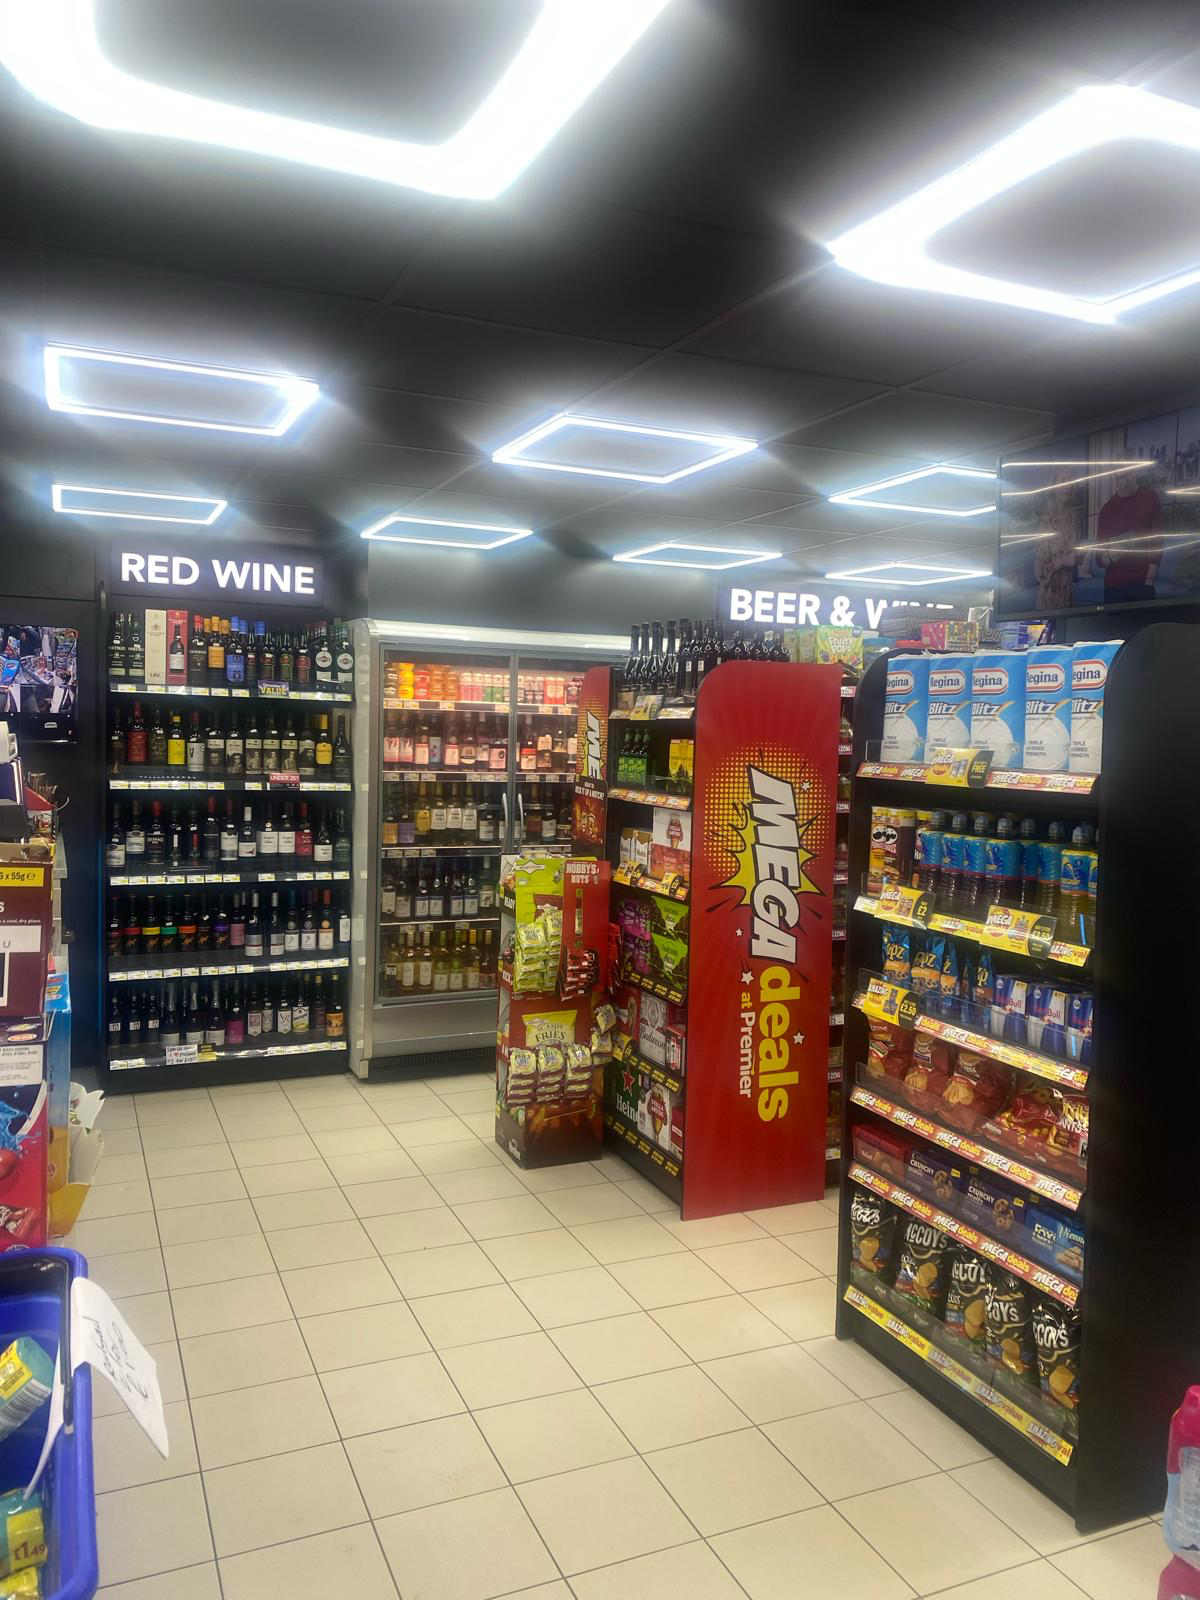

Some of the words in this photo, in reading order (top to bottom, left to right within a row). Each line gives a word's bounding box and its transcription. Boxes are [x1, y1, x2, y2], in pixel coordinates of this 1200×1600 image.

[121, 552, 200, 586] RED
[211, 559, 315, 595] WINE
[730, 588, 821, 626] BEER
[829, 595, 856, 628] &
[929, 676, 960, 689] Regina
[260, 687, 287, 695] VALUE
[928, 701, 957, 715] Blitz
[972, 701, 1000, 715] Blitz
[1025, 700, 1057, 714] Blitz
[862, 766, 882, 775] MEGA
[901, 768, 924, 777] MEGA
[971, 764, 986, 774] FREE
[992, 773, 1020, 785] MEGA
[1046, 776, 1076, 788] MEGA
[748, 762, 802, 964] MEGA
[11, 872, 26, 881] 55g
[571, 874, 589, 884] NUTS
[880, 891, 901, 900] MEGA
[917, 905, 927, 917] £2
[986, 914, 1013, 926] MEGA
[740, 991, 751, 1009] at
[1008, 999, 1022, 1009] Bull
[901, 1003, 917, 1017] £2.50
[1048, 1008, 1061, 1019] Bull
[535, 1031, 566, 1043] FRIES
[942, 1025, 969, 1043] MEGA
[757, 965, 801, 1122] deals
[739, 1011, 756, 1098] Premier
[854, 1092, 876, 1107] MEGA
[874, 1099, 892, 1114] deals
[893, 1110, 917, 1127] MEGA
[915, 1119, 935, 1134] deals
[936, 1131, 962, 1149] MEGA
[960, 1140, 982, 1157] deals
[983, 1153, 1010, 1172] MEGA
[1009, 1162, 1034, 1181] deals
[1035, 1178, 1067, 1200] MEGA
[910, 1159, 935, 1175] CRUNCHY
[968, 1185, 995, 1204] CRUNCHY
[852, 1168, 874, 1184] MEGA
[872, 1176, 890, 1192] deals
[891, 1190, 915, 1208] MEGA
[912, 1200, 933, 1217] deals
[933, 1215, 959, 1233] MEGA
[957, 1225, 979, 1243] deals
[980, 1241, 1009, 1261] MEGA
[1007, 1253, 1031, 1273] deals
[1033, 1270, 1064, 1294] MEGA
[867, 1303, 884, 1320] value
[886, 1319, 909, 1338] AMAZING
[907, 1333, 926, 1350] value
[951, 1365, 972, 1384] value
[1002, 1402, 1023, 1422] value
[1028, 1422, 1057, 1449] AMAZING
[14, 1540, 46, 1562] £1.49
